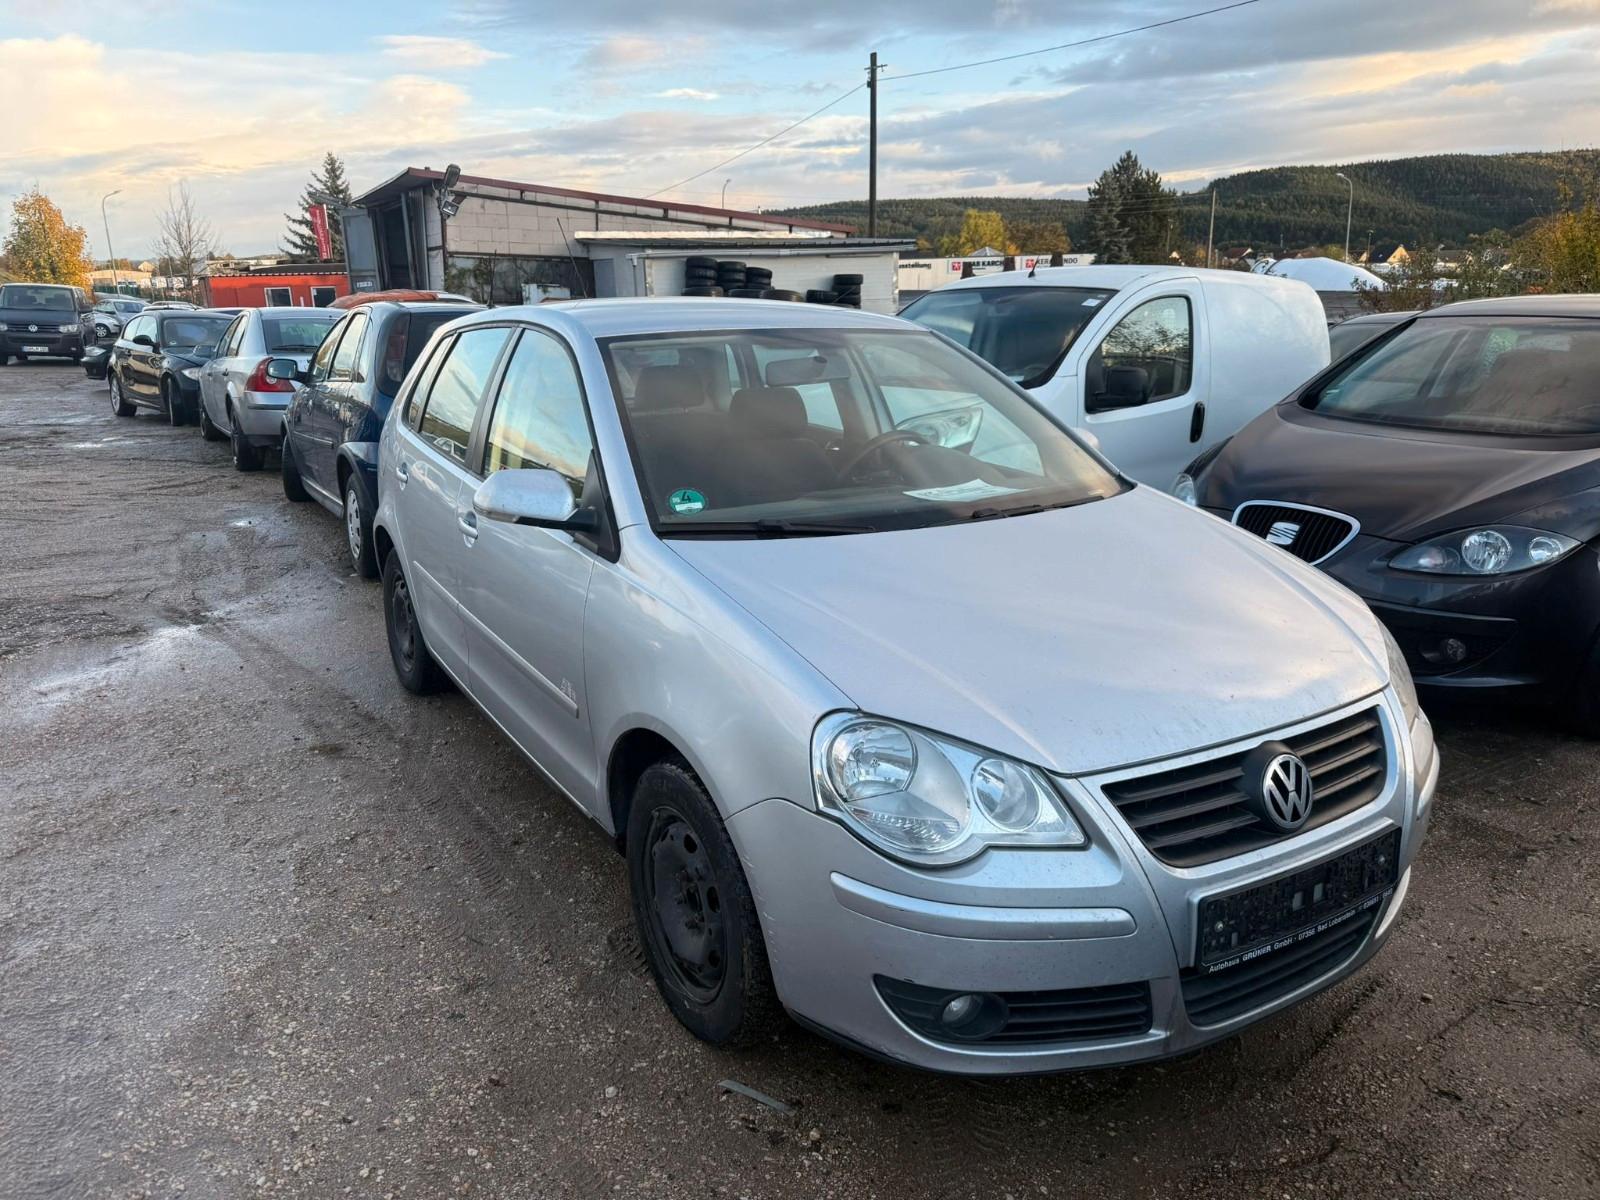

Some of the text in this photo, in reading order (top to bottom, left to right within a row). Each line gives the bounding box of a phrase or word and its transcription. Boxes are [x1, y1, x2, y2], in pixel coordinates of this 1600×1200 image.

[681, 491, 692, 503] 4
[1208, 958, 1240, 974] Autohaus
[1273, 937, 1293, 950] GmbH
